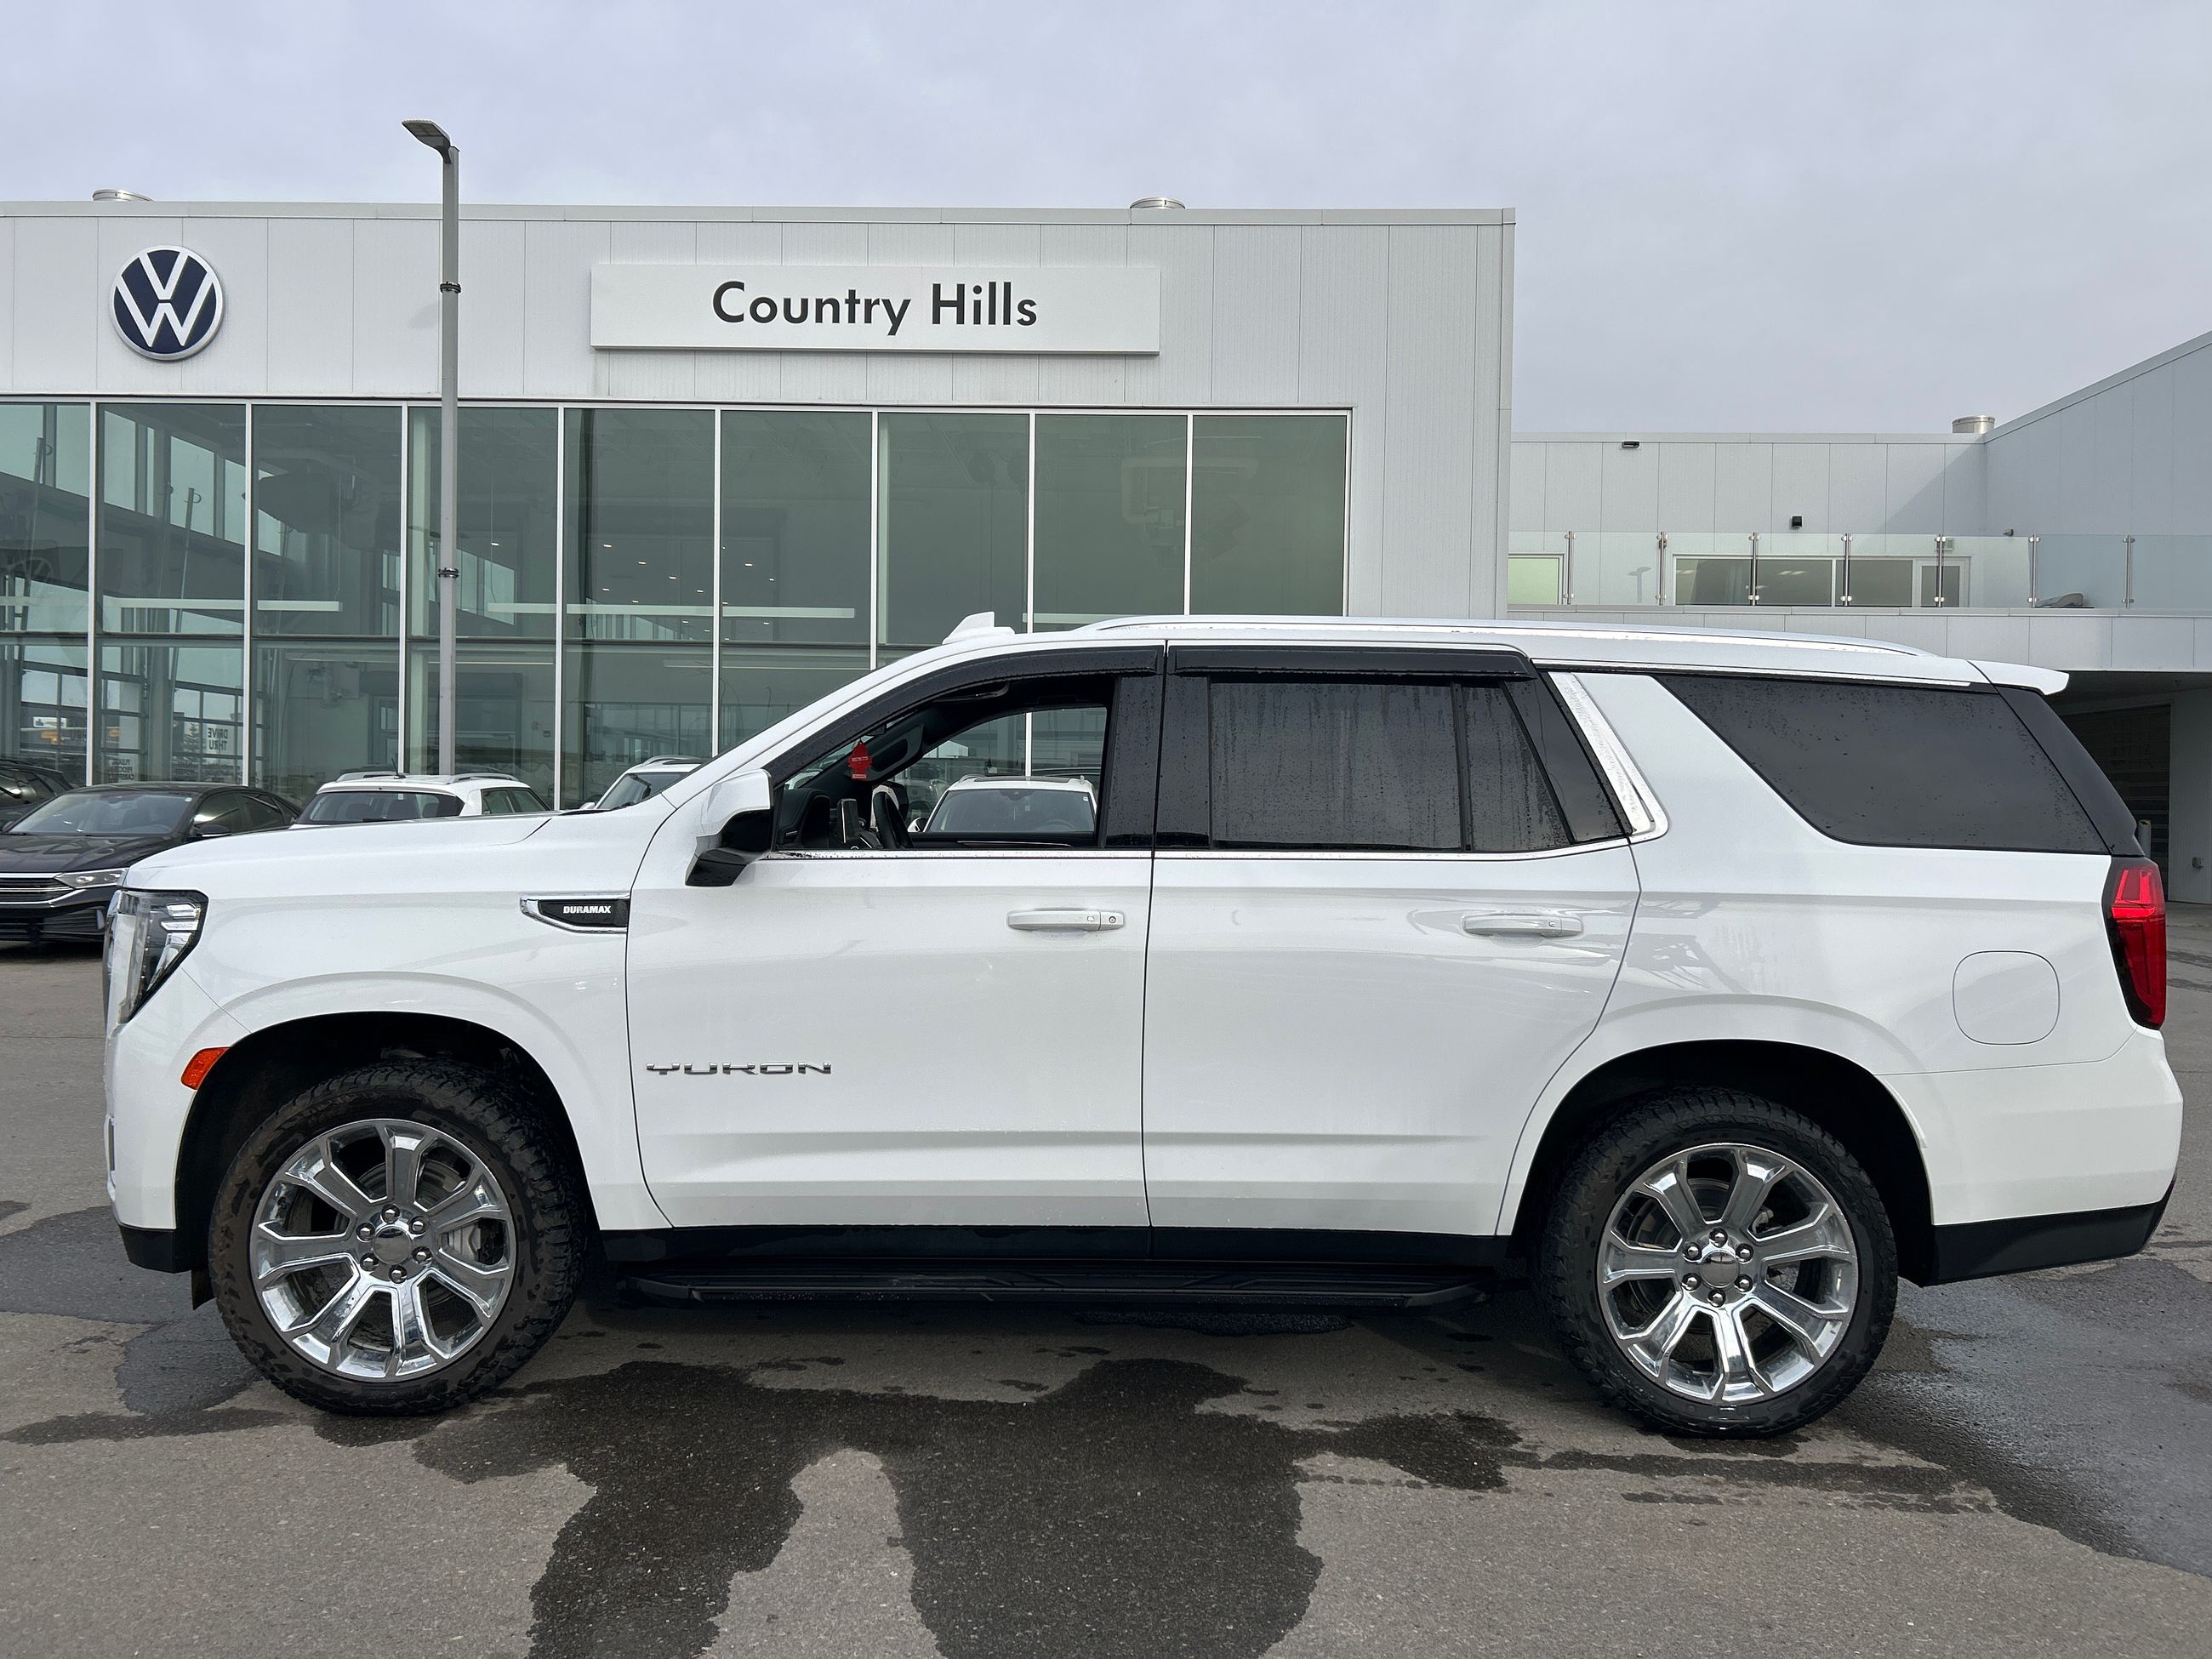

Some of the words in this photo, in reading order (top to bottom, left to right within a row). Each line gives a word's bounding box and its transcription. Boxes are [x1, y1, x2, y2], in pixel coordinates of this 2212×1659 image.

[112, 248, 217, 350] VW
[712, 280, 912, 337] Country
[932, 281, 1037, 327] Hills
[562, 905, 612, 914] DURAMAX
[646, 1063, 832, 1075] YUKON
